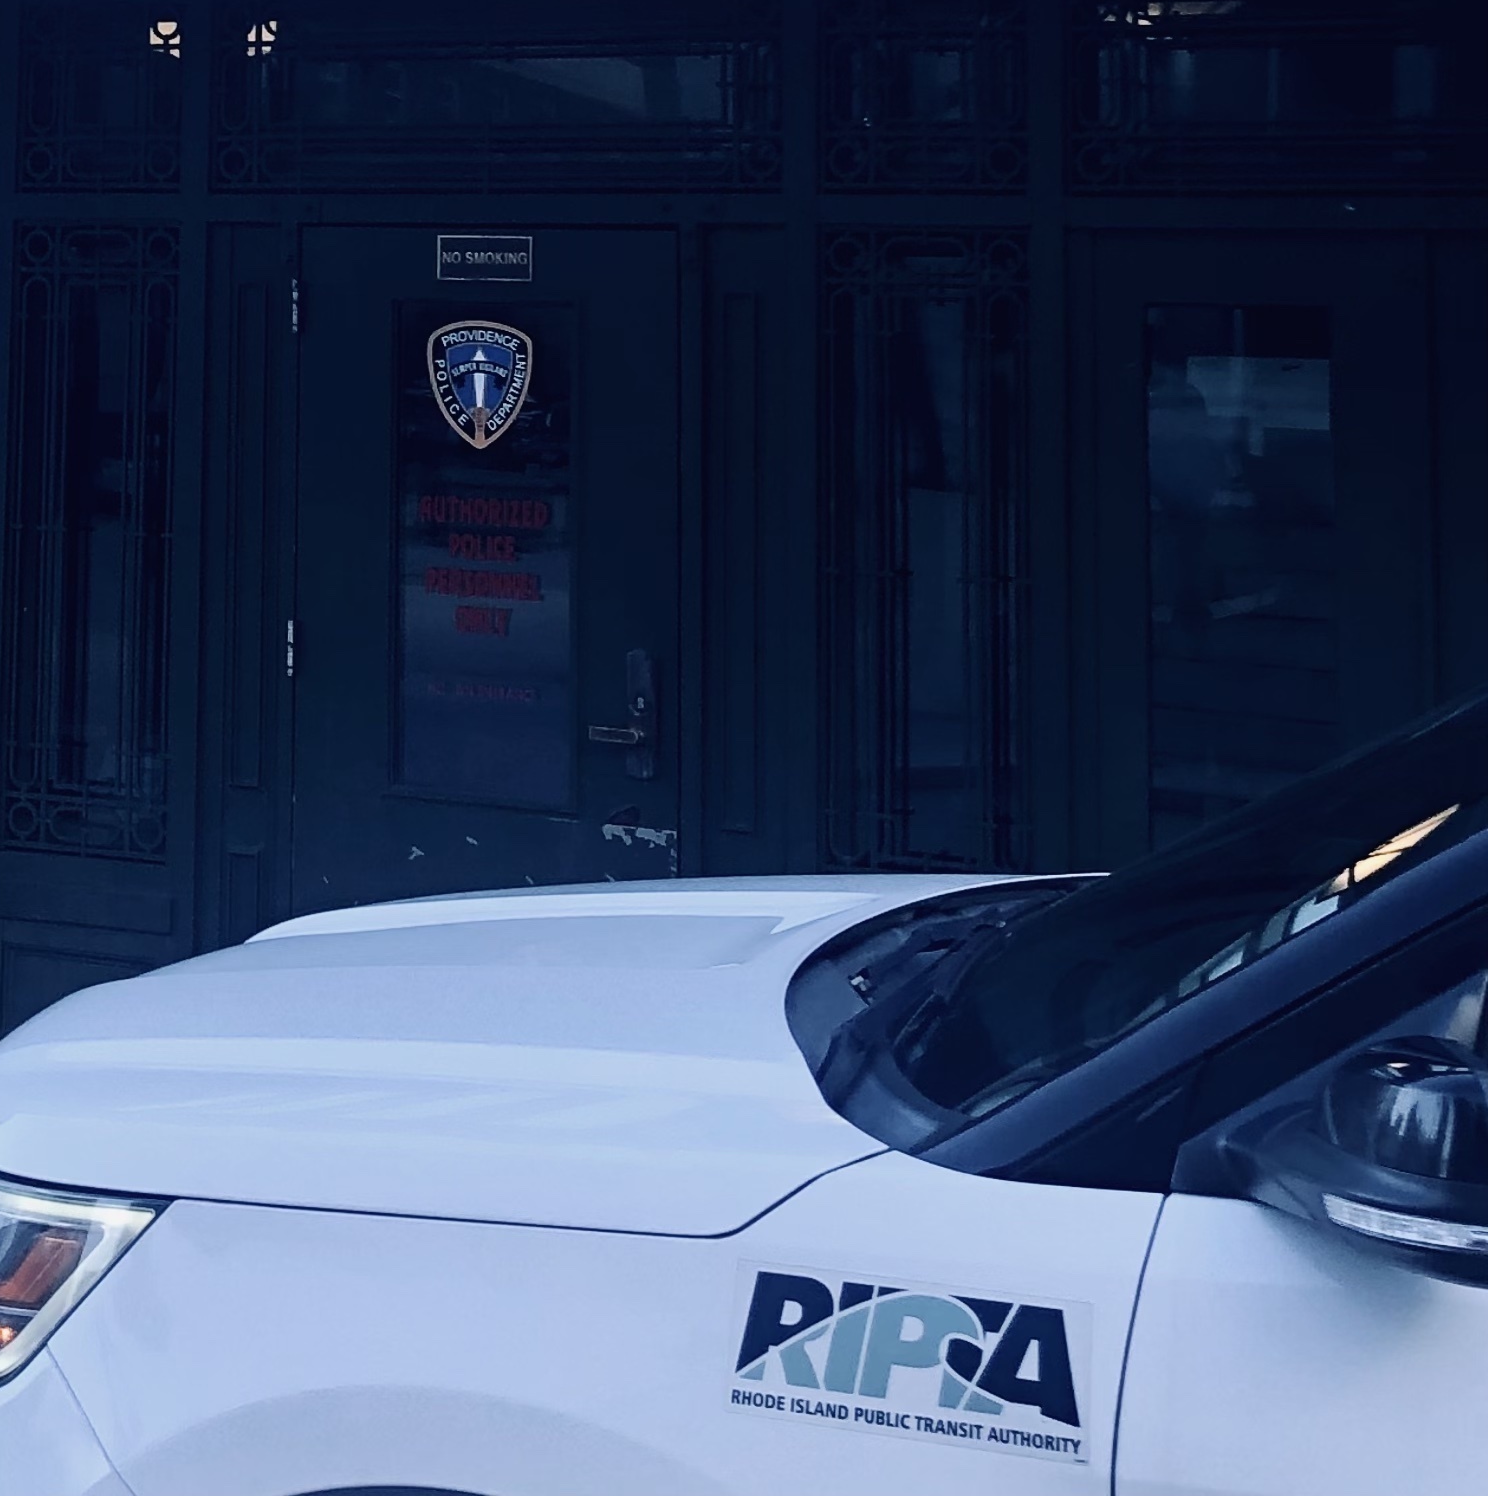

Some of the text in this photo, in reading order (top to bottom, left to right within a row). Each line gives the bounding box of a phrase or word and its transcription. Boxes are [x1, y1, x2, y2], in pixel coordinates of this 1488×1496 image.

[442, 251, 528, 265] NO SMOKING
[441, 330, 521, 351] PROVIDENCE
[434, 359, 470, 426] POLICE
[486, 353, 527, 431] DEPARTMENT
[419, 495, 549, 529] AUTHORIZED
[449, 533, 518, 562] POLICE
[735, 1271, 1081, 1427] RIPTA
[731, 1389, 1082, 1455] RHODE ISLAND PUBLIC TRANSIT AUTHORITY
